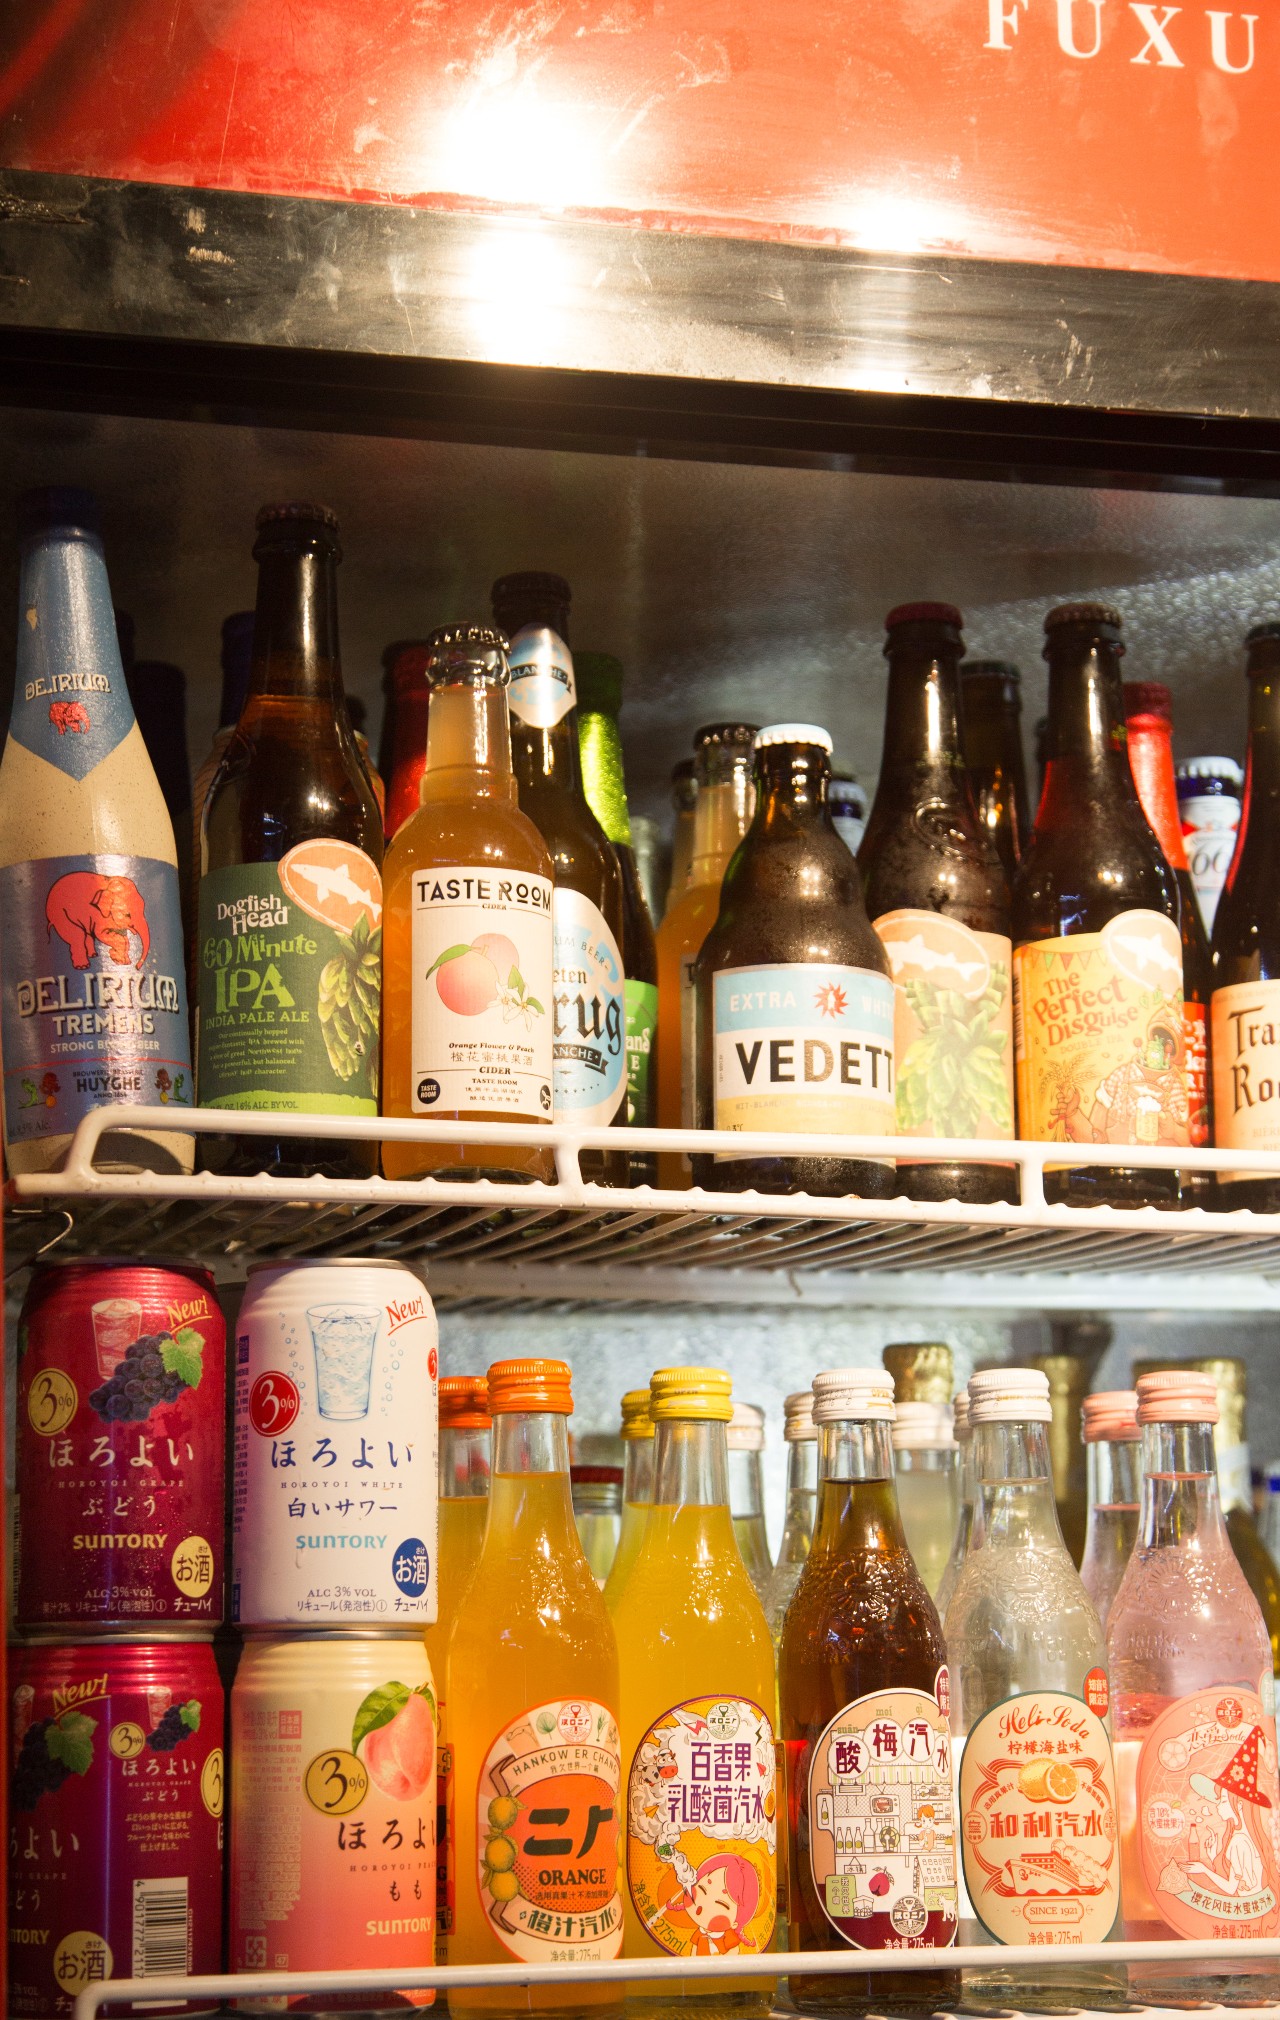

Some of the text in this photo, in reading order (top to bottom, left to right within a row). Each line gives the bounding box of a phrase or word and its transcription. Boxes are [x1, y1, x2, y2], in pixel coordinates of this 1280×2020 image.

[983, 0, 1259, 74] FUXU
[25, 672, 111, 701] DELIRIUM
[217, 894, 282, 921] Dogfish
[417, 878, 551, 911] TASTE ROOM
[482, 903, 507, 911] CIDER
[232, 906, 289, 935] Head
[203, 933, 318, 969] 60 Minute
[17, 973, 179, 1017] DELIRIUM
[215, 963, 296, 1014] IPA
[1044, 972, 1080, 997] The
[730, 990, 797, 1012] EXTRA
[1033, 975, 1128, 1026] Perfect
[52, 1013, 156, 1037] TREMENS
[205, 1011, 310, 1030] INDIA PALE ALE
[1048, 1007, 1139, 1046] Disguise
[50, 1041, 94, 1054] STRONG
[448, 1042, 478, 1050] Orange
[480, 1042, 506, 1050] Flower
[472, 1077, 495, 1085] TASTE
[479, 1066, 512, 1075] CIDER
[76, 1077, 141, 1093] HUYGHE
[420, 1084, 437, 1092] TASTE
[420, 1091, 437, 1099] ROOM
[168, 1295, 209, 1327] New!
[385, 1296, 424, 1327] New!
[38, 1377, 73, 1428] 3%
[260, 1379, 295, 1429] 3%
[50, 1436, 193, 1468] ほろよい
[271, 1436, 413, 1469] ほろよい
[58, 1478, 185, 1489] HOROYOI GRAPE
[280, 1481, 404, 1489] HOROYOI WHITE
[83, 1495, 157, 1517] ぶどう
[288, 1497, 398, 1519] 白いサワー
[176, 1554, 210, 1584] お酒
[395, 1555, 428, 1585] お酒
[84, 1586, 156, 1599] ALC 3% VOL
[174, 1597, 212, 1612] チューハイ
[308, 1586, 377, 1598] ALC 3% VOL
[394, 1598, 429, 1612] チューハイ
[53, 1673, 109, 1711] New!
[1048, 1705, 1090, 1740] Soda
[118, 1722, 143, 1753] 3%
[1007, 1740, 1084, 1755] 柠檬海盐味
[122, 1757, 197, 1777] ほろよい
[513, 1749, 617, 1776] HANKOW ER CHANG
[691, 1742, 752, 1782] 百香果
[321, 1755, 365, 1809] 3%
[142, 1789, 180, 1802] ぶどう
[668, 1784, 764, 1823] 乳酸菌汽水
[989, 1809, 1104, 1839] 和利汽水
[350, 1863, 411, 1872] HOROYOI
[538, 1868, 607, 1886] ORANGE
[389, 1879, 422, 1902] もも
[1190, 1891, 1273, 1915] 樱花风味水蜜桃汽水
[527, 1907, 615, 1938] 橙汁汽水
[1030, 1906, 1078, 1915] SINCE 1921
[57, 1950, 106, 1981] お酒
